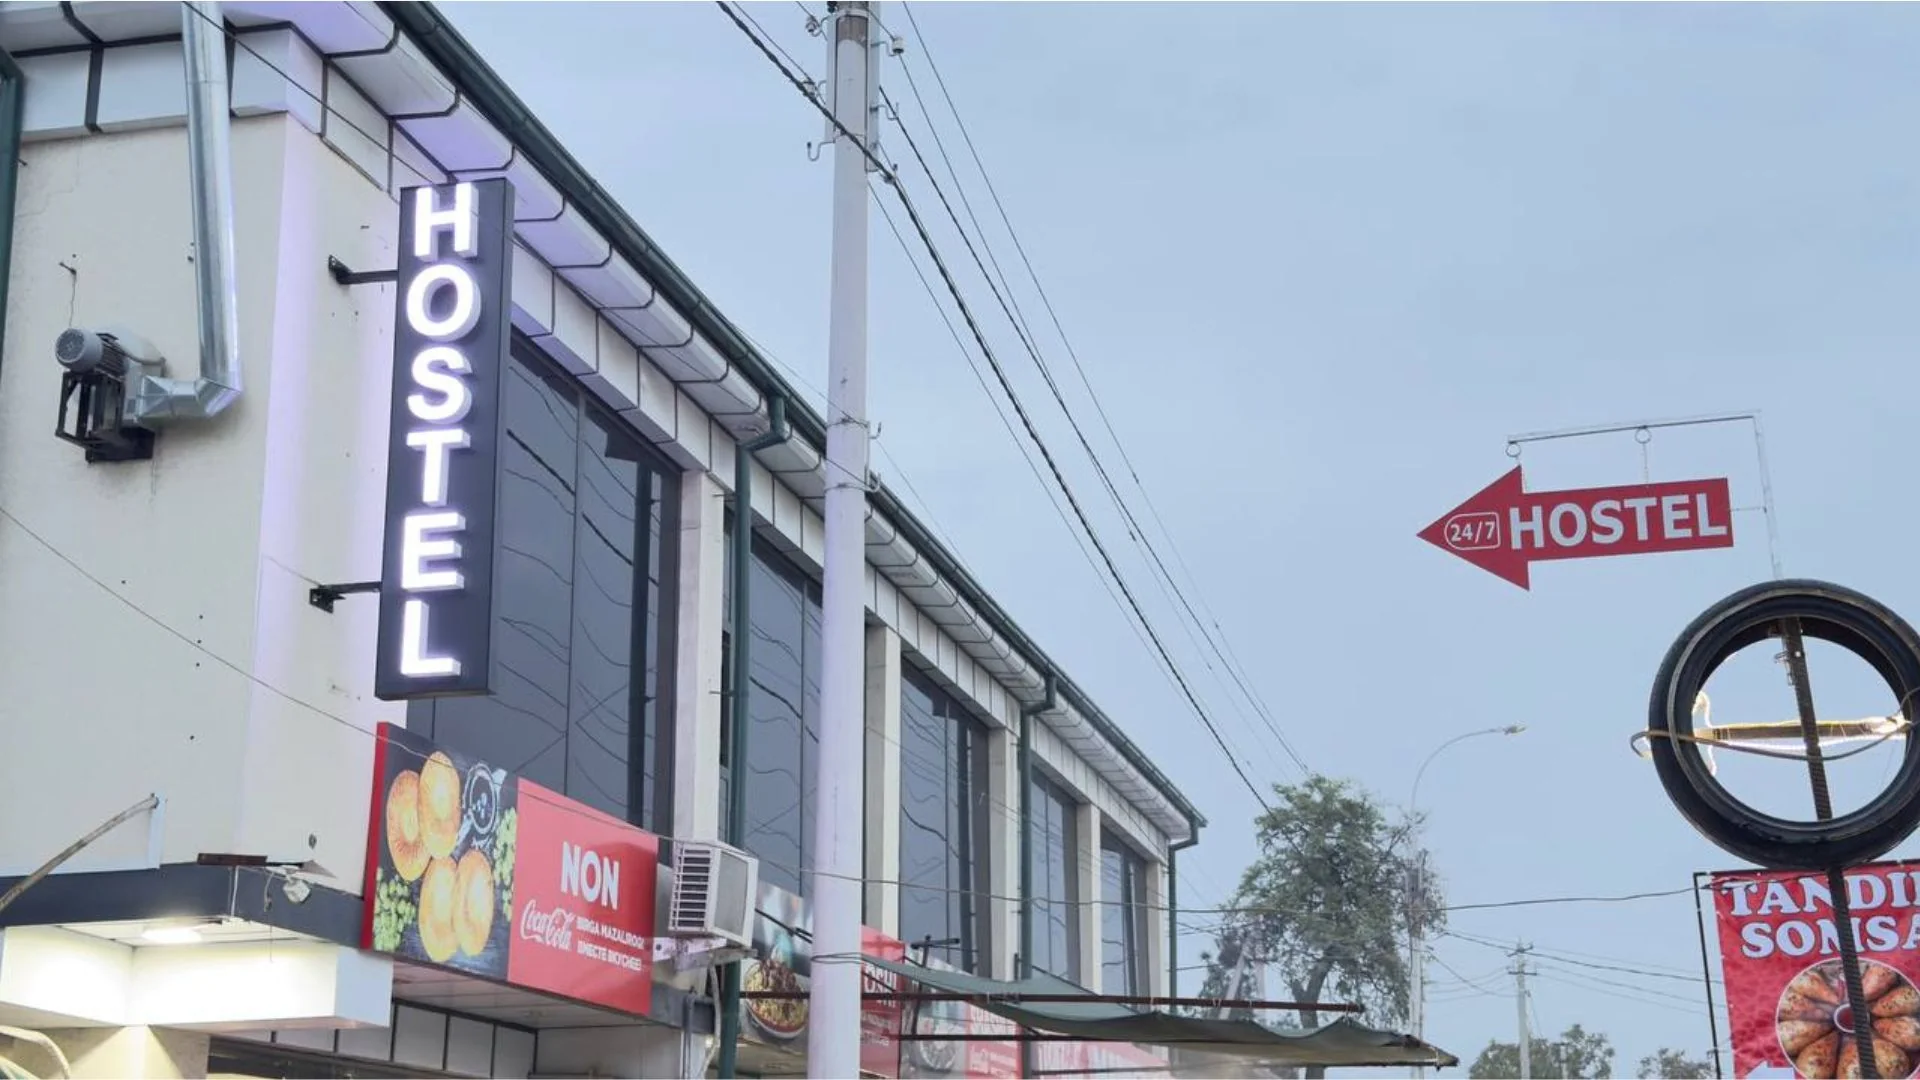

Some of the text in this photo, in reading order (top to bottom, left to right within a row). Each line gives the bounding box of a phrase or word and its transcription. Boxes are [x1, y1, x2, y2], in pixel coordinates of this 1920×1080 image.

[400, 181, 480, 677] HOSTEL
[1450, 521, 1496, 544] 24/7
[1508, 493, 1728, 549] HOSTEL
[560, 841, 620, 910] NON
